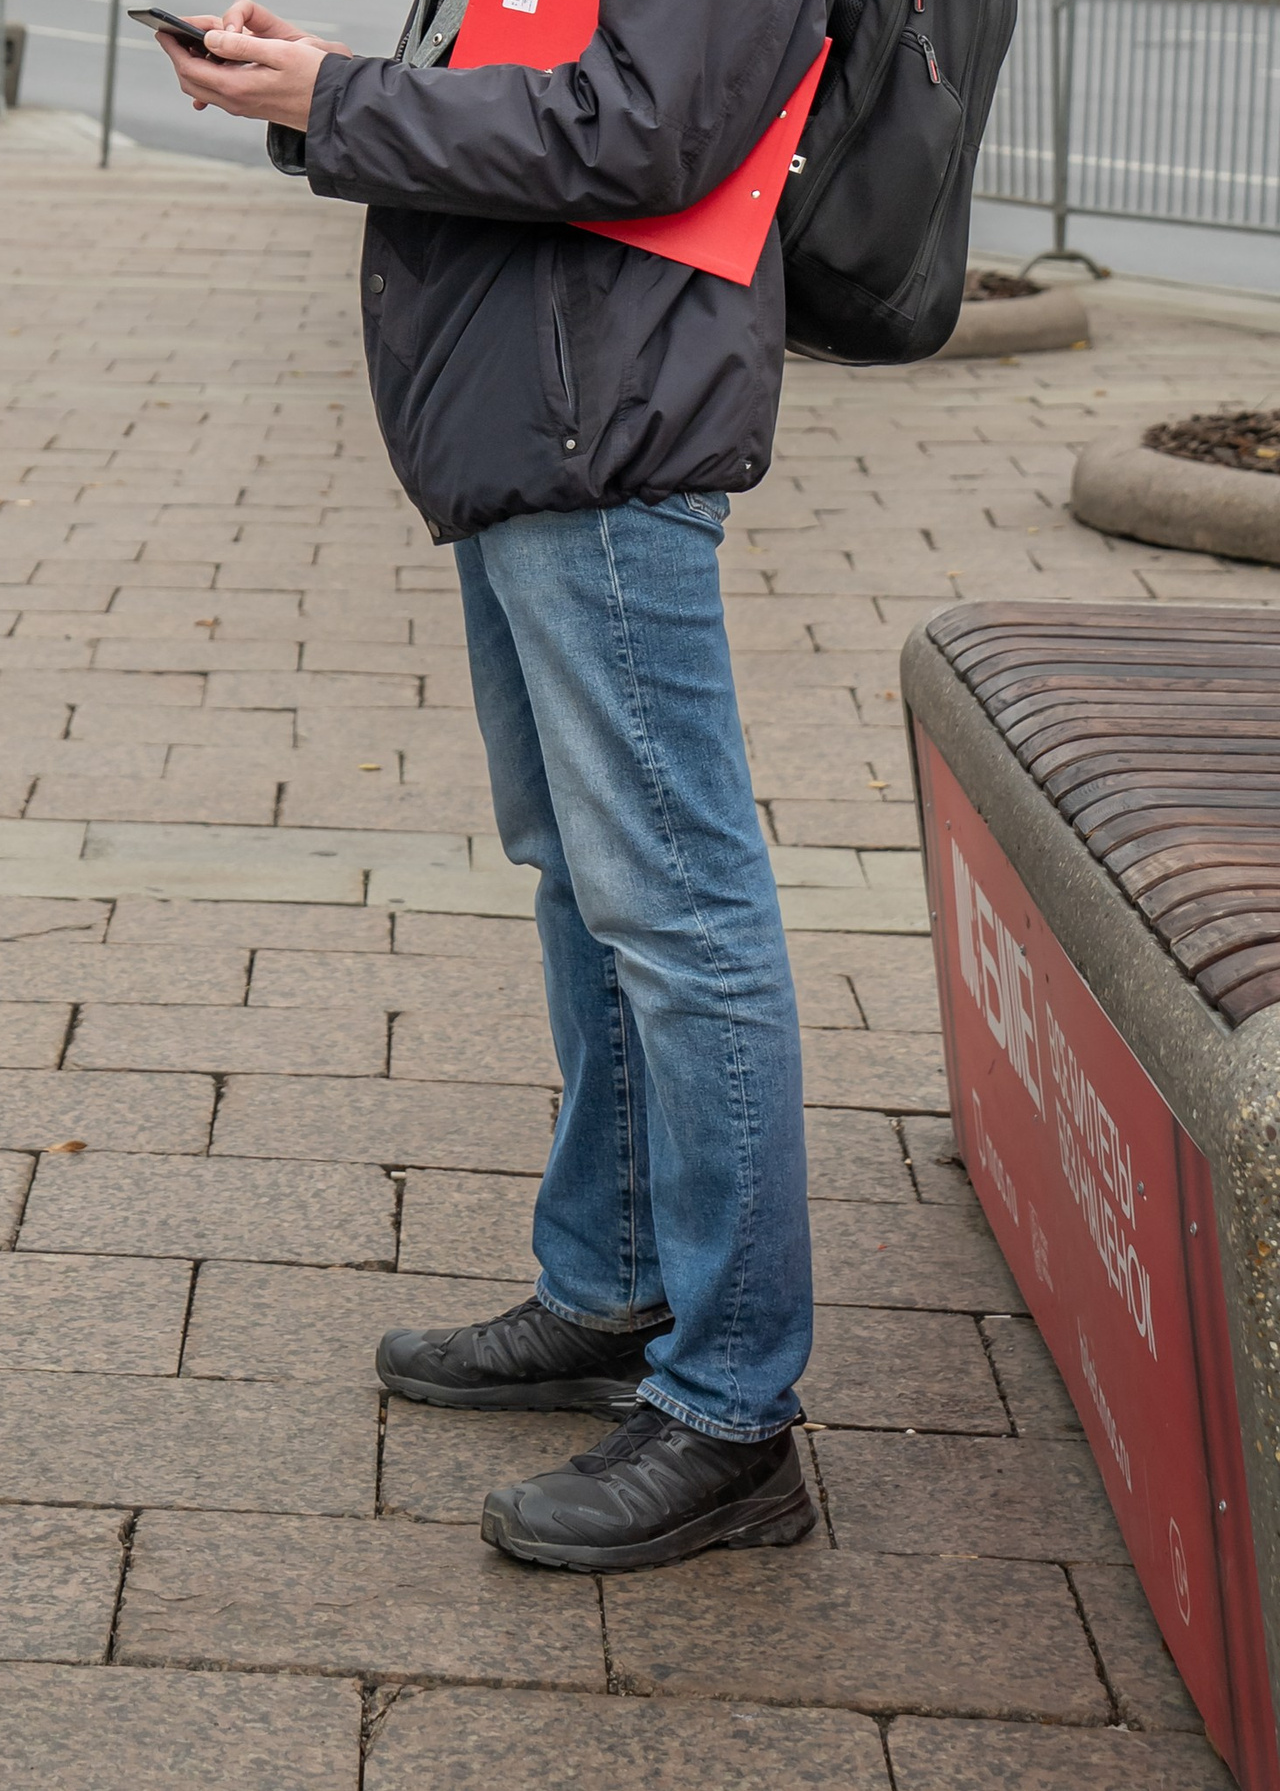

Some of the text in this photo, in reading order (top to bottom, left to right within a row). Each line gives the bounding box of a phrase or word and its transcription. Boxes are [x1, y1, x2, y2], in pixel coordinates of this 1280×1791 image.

[1045, 1000, 1136, 1231] ВСЕ БИЛЕТЫ
[1055, 1095, 1158, 1362] БЕЗ НАЦЕНОК
